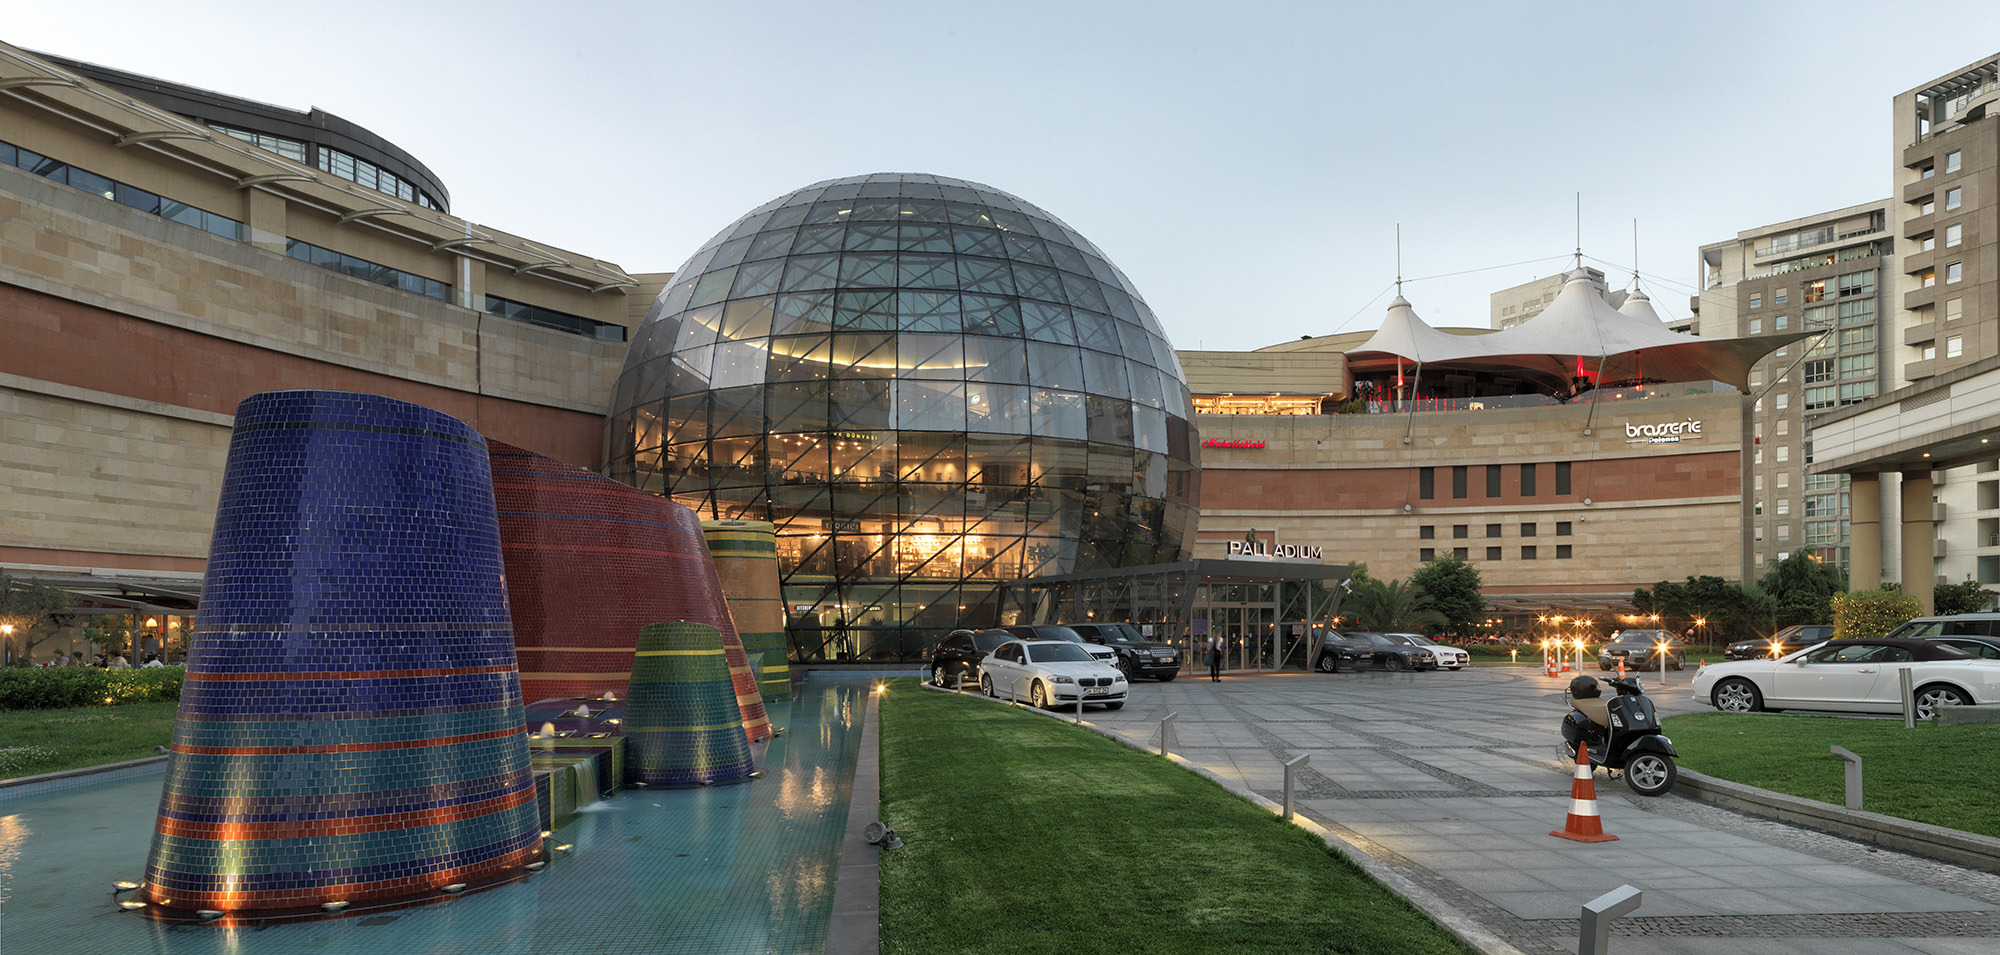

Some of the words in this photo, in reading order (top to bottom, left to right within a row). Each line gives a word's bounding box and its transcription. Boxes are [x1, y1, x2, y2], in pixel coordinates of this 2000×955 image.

[846, 432, 878, 441] DÜNYASI
[1625, 417, 1701, 438] brasserie
[1228, 541, 1323, 559] PALLADIUM
